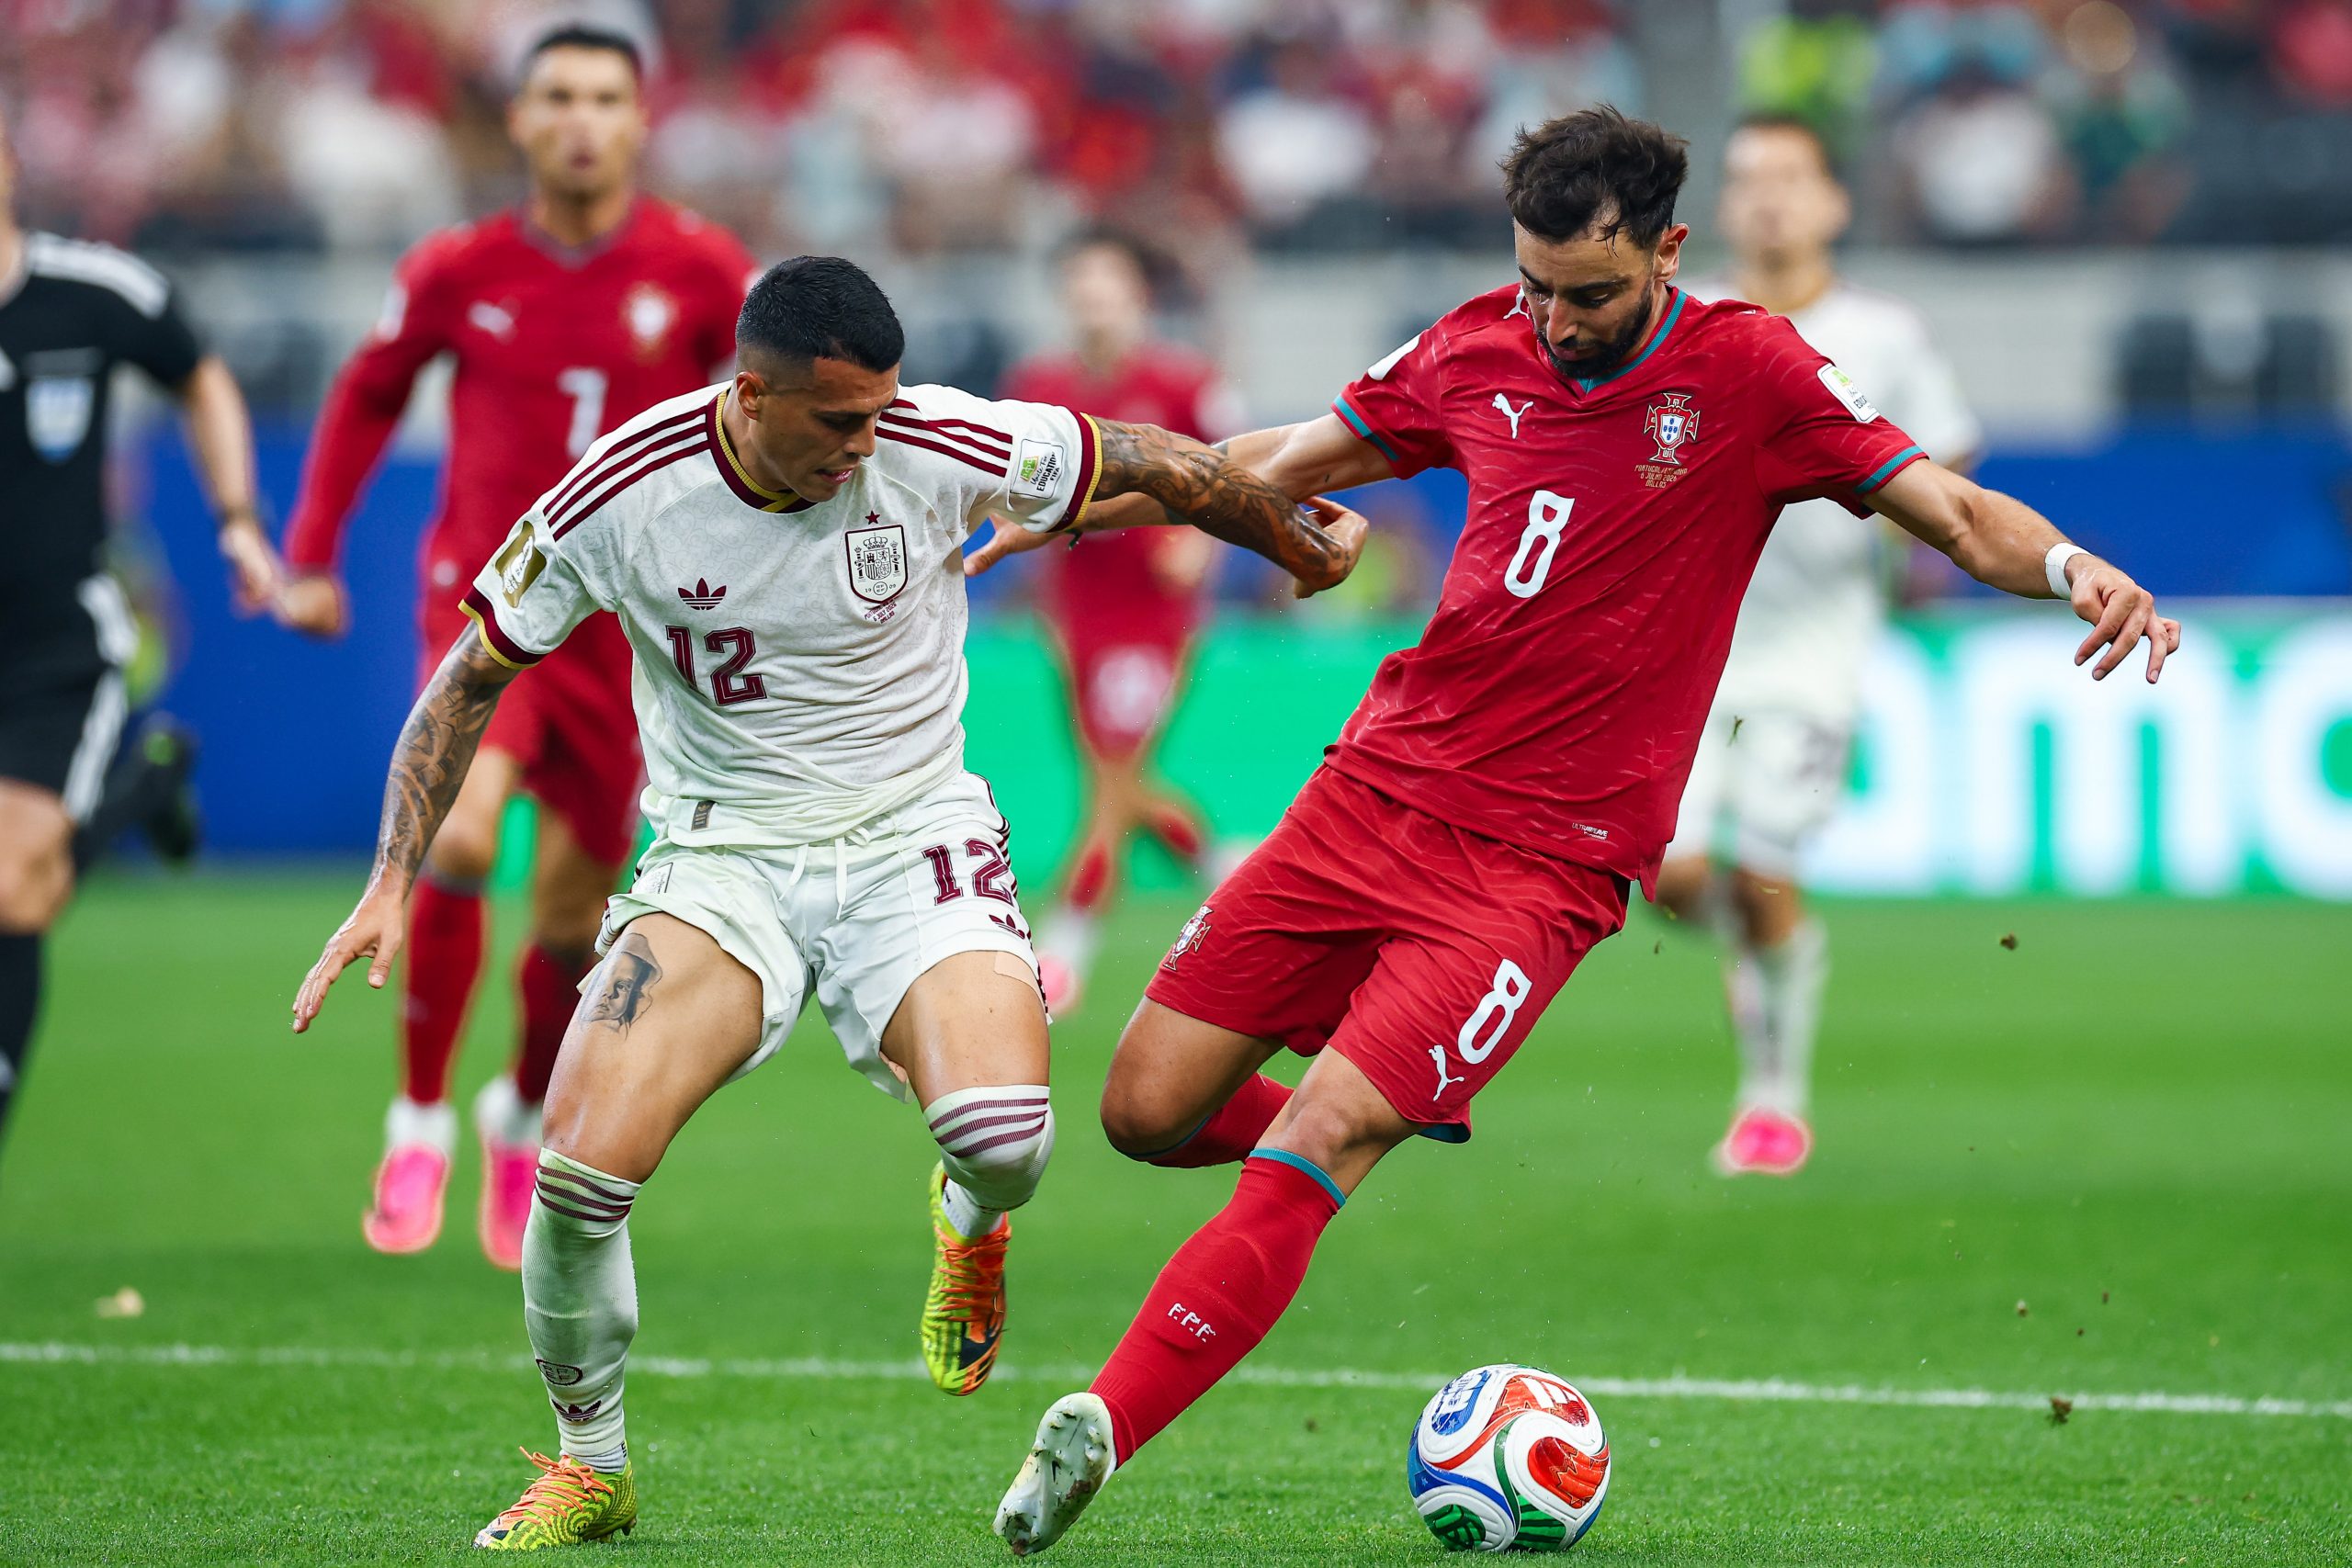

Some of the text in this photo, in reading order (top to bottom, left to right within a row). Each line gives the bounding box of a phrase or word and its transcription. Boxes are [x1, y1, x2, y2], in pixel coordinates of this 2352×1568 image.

[557, 367, 608, 459] 7
[1050, 467, 1060, 481] FIFA
[1504, 490, 1576, 599] 8
[665, 626, 767, 706] 12
[922, 838, 1014, 906] 12
[1458, 958, 1532, 1065] 8
